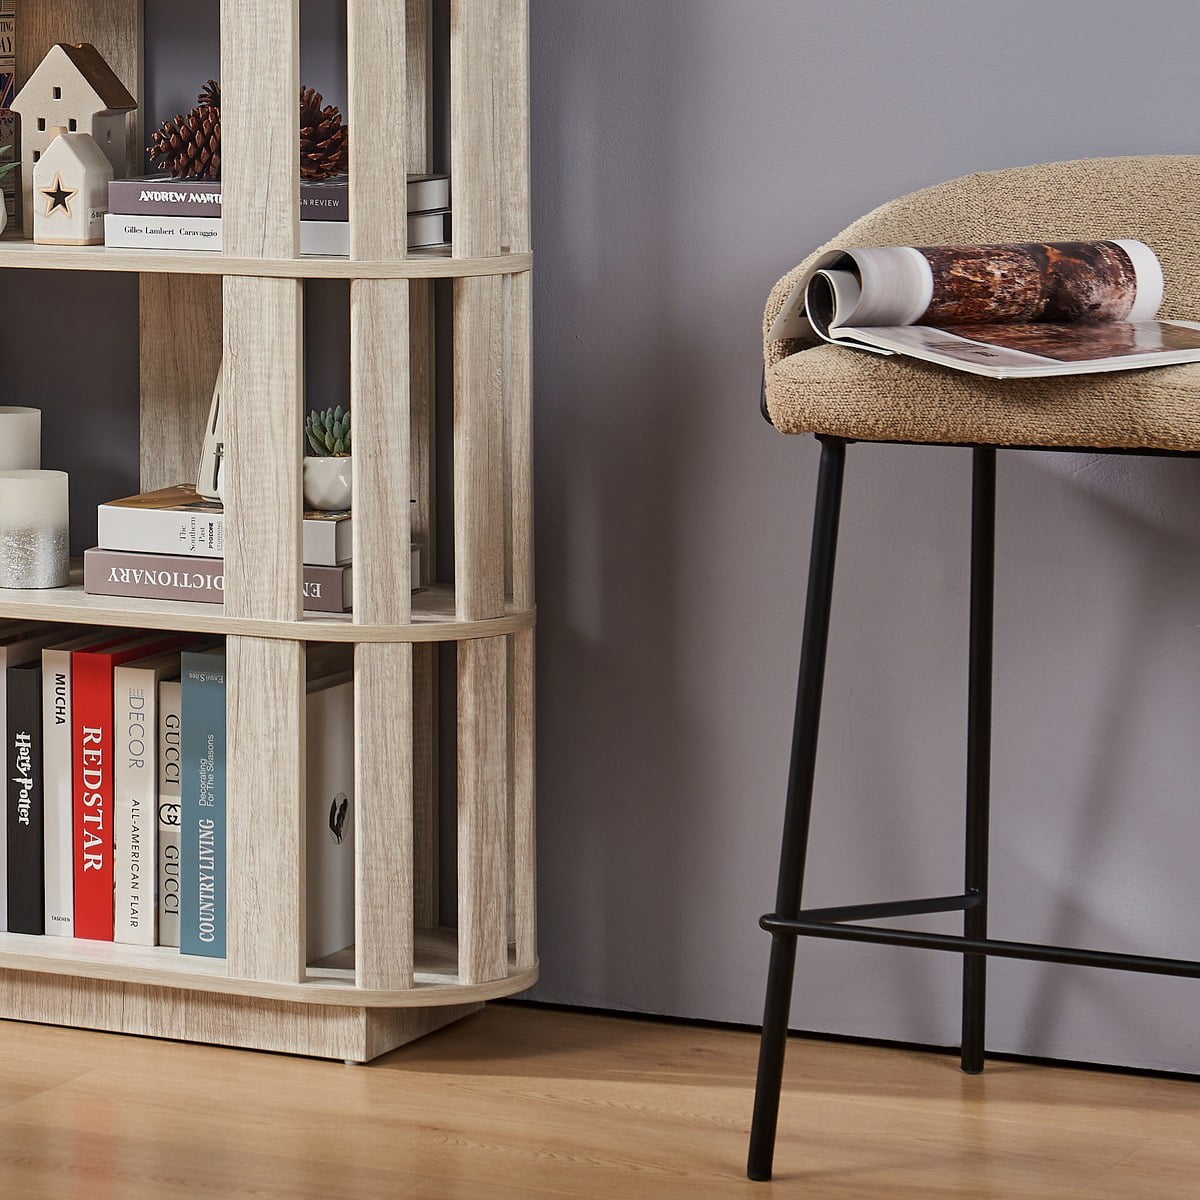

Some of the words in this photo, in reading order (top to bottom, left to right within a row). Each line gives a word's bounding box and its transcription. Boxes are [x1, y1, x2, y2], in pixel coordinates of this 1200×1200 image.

[139, 190, 187, 203] ANDREW
[310, 199, 340, 207] REVIEW
[124, 225, 143, 234] Gilles
[145, 226, 174, 235] Lambert
[179, 227, 218, 237] Caravaggio
[107, 567, 224, 591] DICTIONARY
[55, 674, 66, 725] MUCHA
[15, 731, 32, 777] Harry
[128, 696, 145, 769] DECOR
[165, 714, 180, 785] GUCCI
[206, 734, 214, 771] Seasons
[12, 777, 33, 826] Potter
[82, 725, 103, 872] REDSTAR
[199, 758, 208, 807] Decorating
[206, 773, 214, 791] The
[130, 799, 141, 890] ALL-AMERICAN
[199, 819, 215, 871] LIVING
[164, 845, 180, 916] GUCCI
[130, 895, 139, 928] FLAIR
[199, 872, 215, 943] COUNTRY
